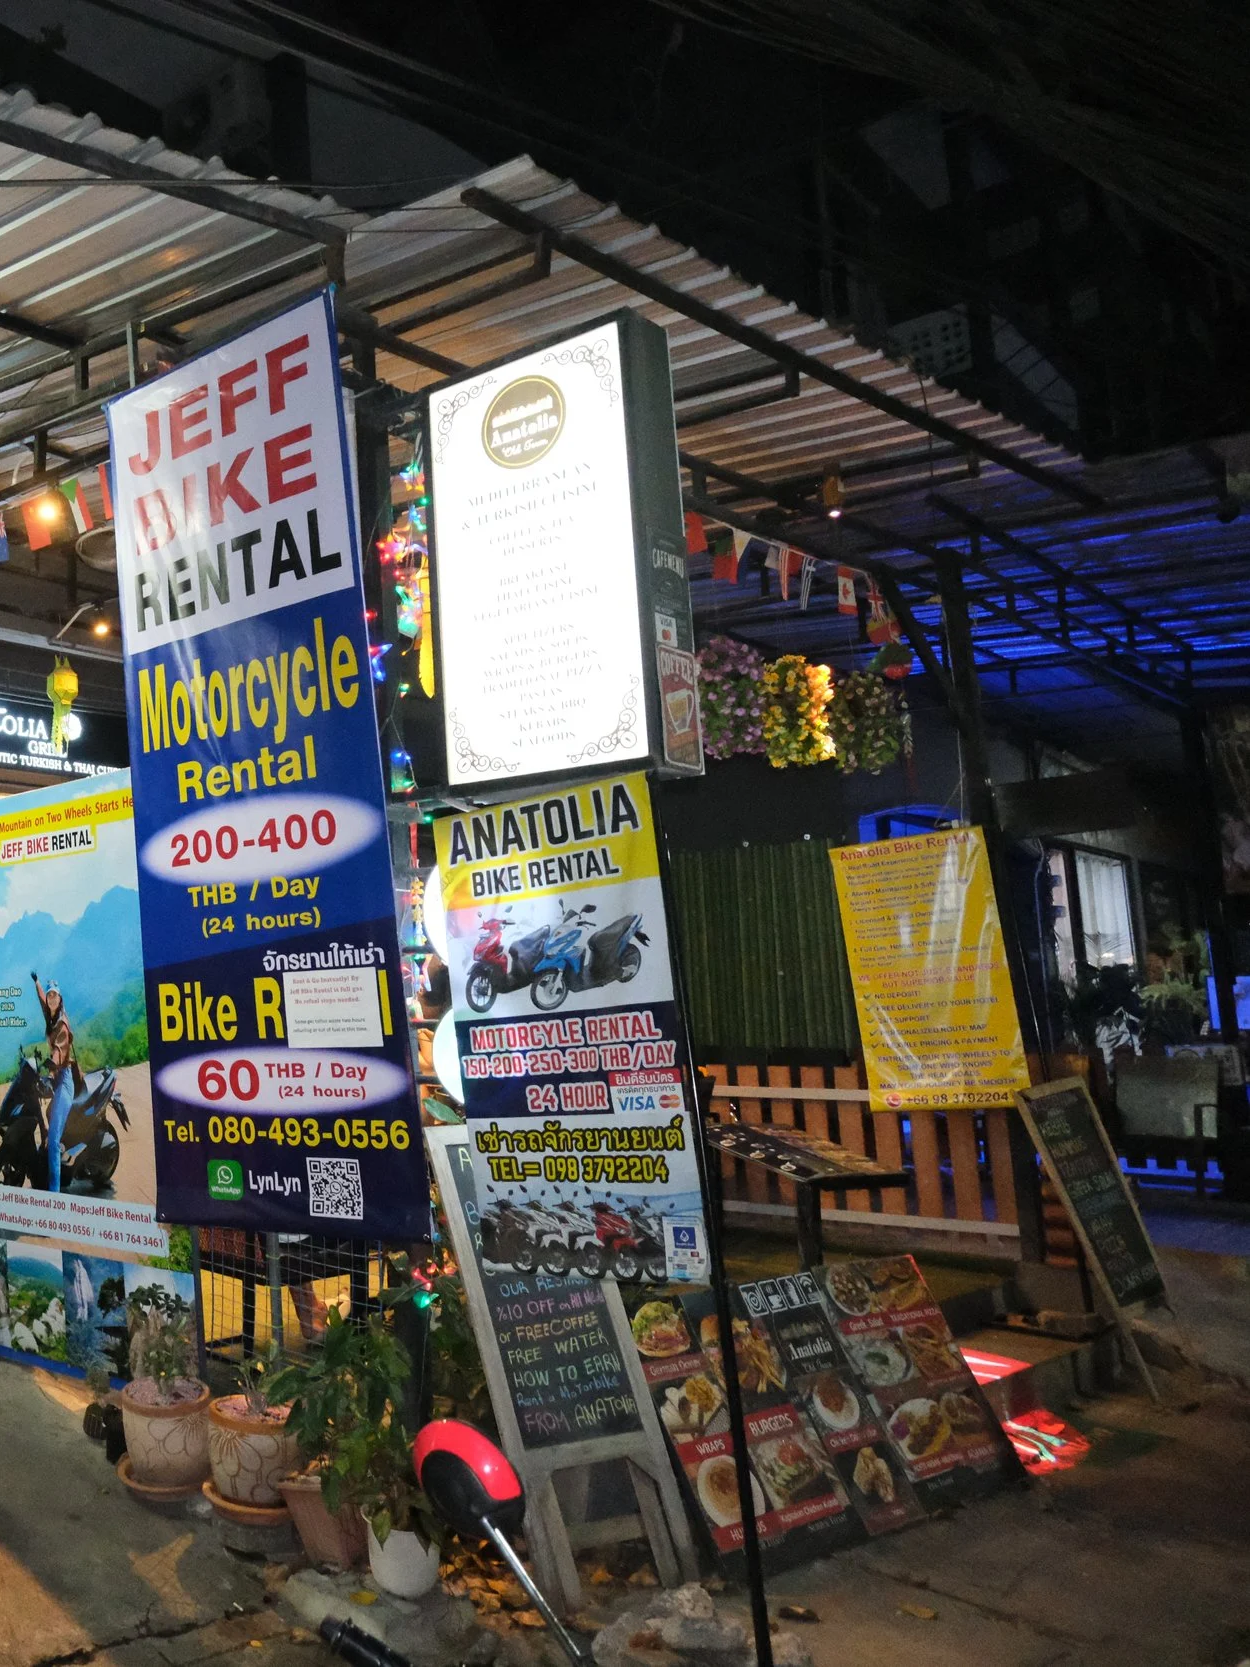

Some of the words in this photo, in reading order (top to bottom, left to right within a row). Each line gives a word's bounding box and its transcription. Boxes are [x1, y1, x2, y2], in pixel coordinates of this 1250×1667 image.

[128, 333, 310, 477] JEFF
[133, 423, 318, 557] BIKE
[135, 507, 342, 633] RENTAL
[660, 651, 694, 685] COFFEE
[138, 616, 359, 754] Motorcycle
[19, 754, 62, 770] TURKISH
[64, 761, 72, 771] &
[177, 735, 317, 803] Rental
[0, 816, 32, 835] Mountain
[34, 816, 45, 826] on
[46, 811, 63, 825] Two
[64, 804, 93, 822] Wheels
[95, 800, 119, 815] Starts
[122, 795, 134, 809] He
[450, 784, 639, 865] ANATOLIA
[1, 838, 23, 860] JEFF
[26, 836, 50, 855] BIKE
[51, 829, 92, 851] RENTAL
[171, 809, 337, 868] 200-400
[840, 846, 890, 861] Anatolia
[894, 840, 923, 854] Bike
[927, 832, 969, 848] Rental
[472, 864, 520, 898] BIKE
[529, 847, 619, 888] RENTAL
[187, 882, 237, 908] THB
[249, 878, 259, 902] /
[271, 875, 320, 900] Day
[202, 912, 235, 939] (24
[246, 906, 321, 932] hours)
[262, 942, 385, 973] จักรยานให้เช่า
[158, 981, 238, 1042] Bike
[472, 1020, 581, 1050] MOTORCYLE
[588, 1014, 659, 1039] RENTAL
[464, 1050, 597, 1076] 150-200-250-300
[602, 1044, 675, 1068] THB/DAY
[197, 1059, 260, 1101] 60
[264, 1063, 306, 1079] THB
[315, 1062, 322, 1079] /
[330, 1062, 367, 1082] Day
[278, 1085, 304, 1100] (24
[313, 1084, 367, 1101] hours)
[615, 1071, 674, 1085] ยินดีรับบัตร
[528, 1087, 555, 1110] 24
[562, 1085, 607, 1109] HOUR
[618, 1096, 655, 1111] VISA
[164, 1120, 200, 1144] Tel.
[208, 1115, 410, 1150] 080-493-0556
[475, 1114, 685, 1152] เช่ารถจักรยานยนต์
[248, 1170, 301, 1196] LynLyn
[488, 1157, 541, 1181] TEL=
[544, 1157, 579, 1181] 098
[583, 1156, 669, 1182] 3792204
[2, 1193, 14, 1203] Jeff
[15, 1194, 29, 1205] Bike
[30, 1196, 51, 1209] Rental
[53, 1199, 66, 1211] 200
[70, 1202, 105, 1217] Maps:Jeff
[106, 1205, 123, 1220] Bike
[125, 1209, 152, 1224] Rental
[527, 1301, 555, 1315] OFF
[508, 1348, 542, 1366] FREE
[554, 1329, 608, 1354] WATER
[513, 1370, 549, 1388] HOW
[556, 1366, 578, 1383] TO
[584, 1353, 621, 1373] EARN
[748, 1413, 793, 1437] BURGERS
[695, 1438, 726, 1456] WRAPS
